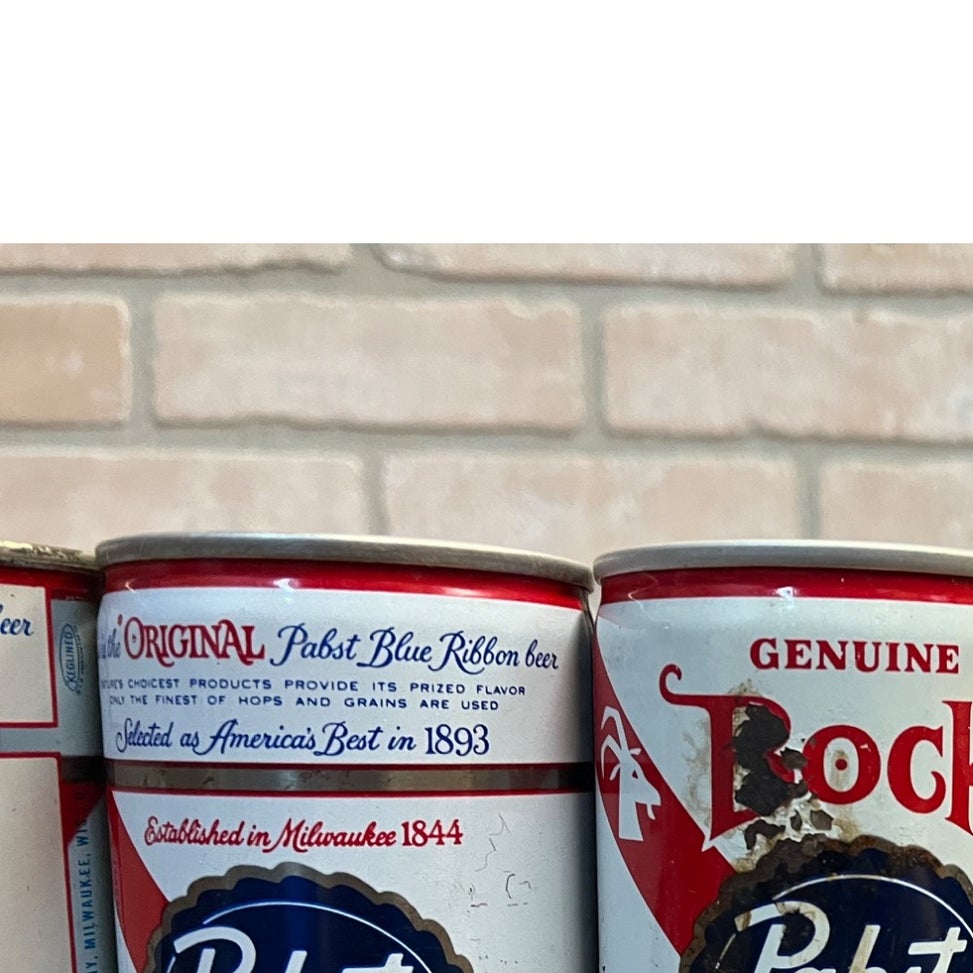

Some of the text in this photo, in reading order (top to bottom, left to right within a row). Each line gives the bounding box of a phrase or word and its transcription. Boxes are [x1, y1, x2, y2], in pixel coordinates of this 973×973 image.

[0, 604, 33, 636] eer
[124, 617, 265, 667] ORIGINAL
[270, 623, 361, 666] Pabst
[357, 627, 432, 668] Blue
[428, 630, 520, 675] Ribbon
[524, 639, 560, 669] beer
[750, 637, 960, 674] GENUINE
[128, 678, 180, 690] CHOICEST
[189, 678, 272, 690] PRODUCTS
[284, 679, 359, 691] PROVIDE
[372, 681, 397, 692] ITS
[410, 682, 466, 694] PRIZED
[476, 684, 526, 696] FLAVOR
[130, 694, 148, 706] THE
[155, 695, 198, 706] FINEST
[207, 695, 226, 706] OF
[239, 696, 283, 707] HOPS
[295, 697, 331, 708] AND
[344, 697, 408, 709] GRAINS
[419, 699, 450, 710] ARE
[461, 700, 499, 711] USED
[115, 717, 490, 757] Selected as America's Best in 1893
[144, 816, 464, 854] Established in Milwaukee 1844
